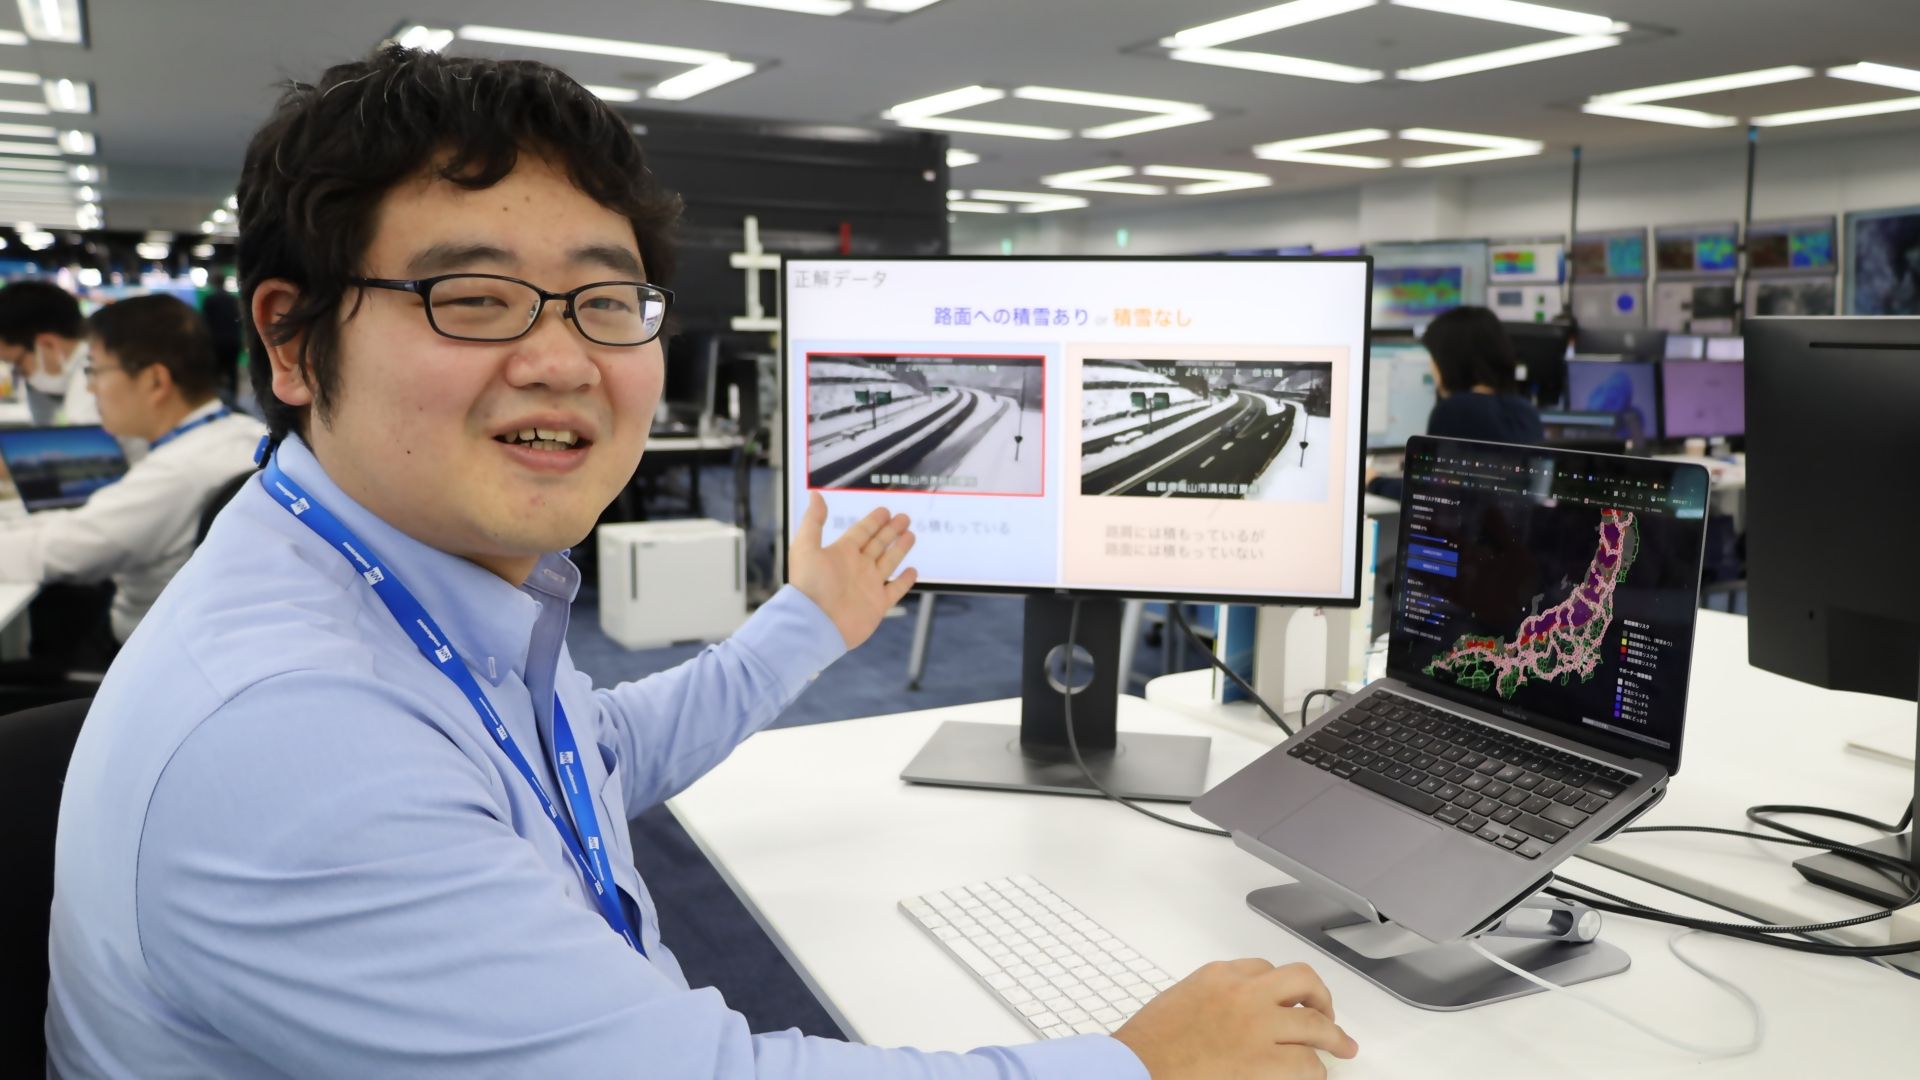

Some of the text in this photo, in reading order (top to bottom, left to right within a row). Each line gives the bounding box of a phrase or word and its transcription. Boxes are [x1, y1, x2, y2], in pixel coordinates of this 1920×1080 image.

[794, 269, 888, 290] 正解データ
[933, 306, 1089, 327] 路面への積雪あり
[1113, 307, 1192, 328] 積雪なし
